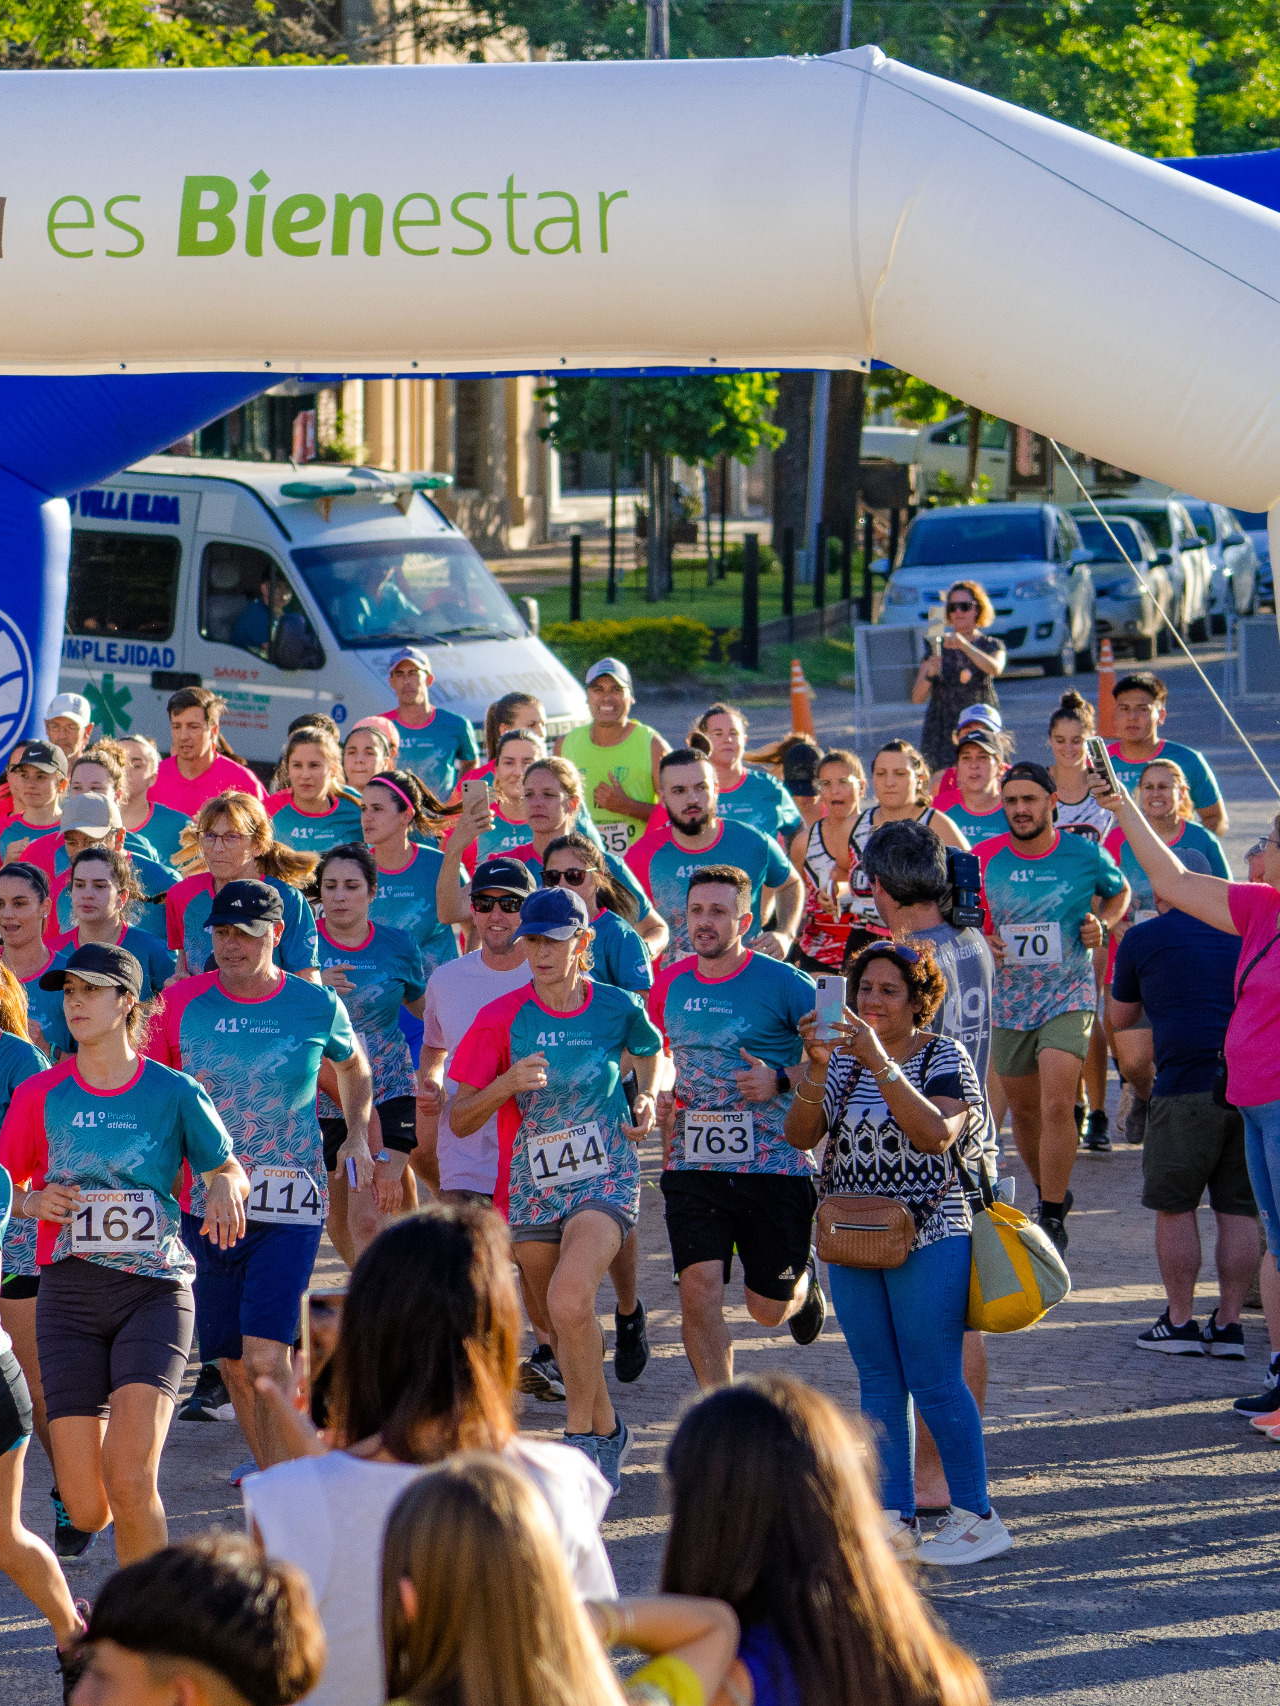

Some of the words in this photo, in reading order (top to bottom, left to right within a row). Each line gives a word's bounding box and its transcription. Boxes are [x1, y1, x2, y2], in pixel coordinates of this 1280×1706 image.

[46, 194, 145, 259] es
[176, 168, 629, 258] Bienestar
[81, 490, 129, 520] VILLA
[1014, 934, 1049, 957] 70
[710, 998, 733, 1007] Prueba
[249, 1017, 279, 1026] Prueba
[249, 1025, 280, 1034] atlética
[566, 1038, 593, 1046] atlética
[107, 1111, 137, 1120] Prueba
[691, 1112, 746, 1124] cronomet
[107, 1120, 138, 1130] atlética
[536, 1125, 587, 1146] cronomet
[687, 1126, 748, 1155] 763
[532, 1135, 605, 1180] 144
[263, 1168, 310, 1180] cronom
[84, 1190, 144, 1203] cronomet
[252, 1179, 321, 1216] 114
[75, 1206, 156, 1241] 162
